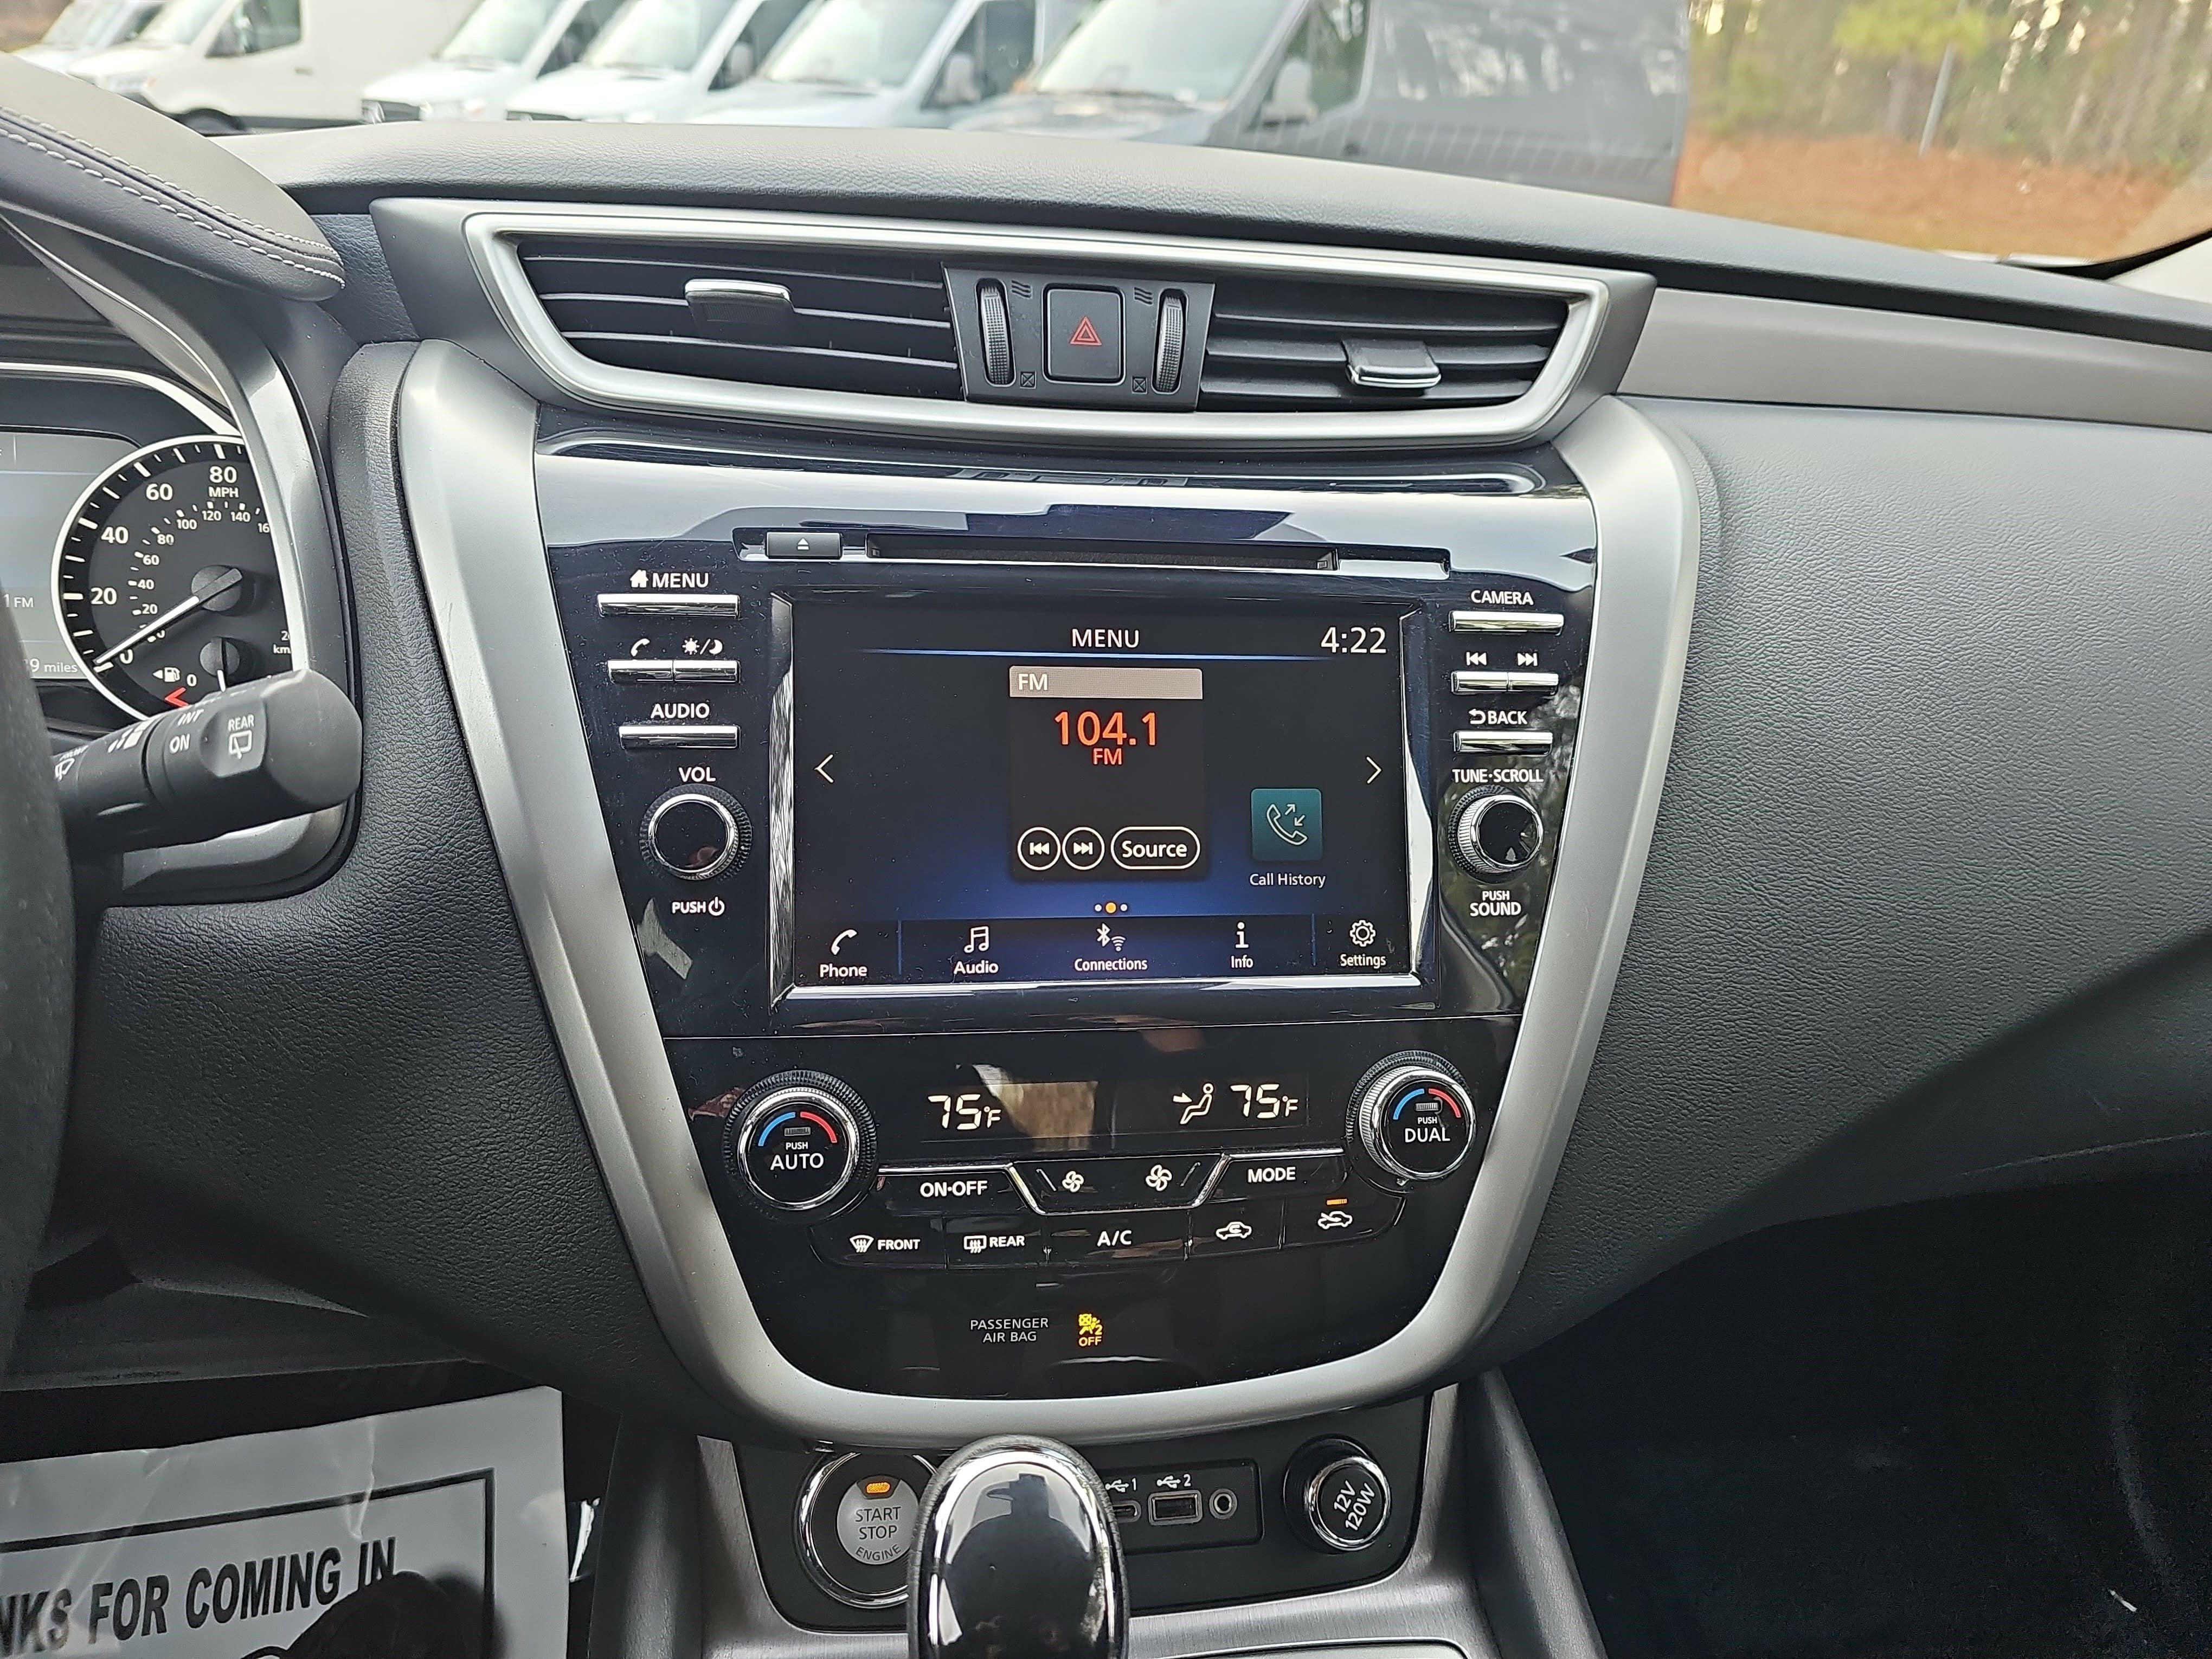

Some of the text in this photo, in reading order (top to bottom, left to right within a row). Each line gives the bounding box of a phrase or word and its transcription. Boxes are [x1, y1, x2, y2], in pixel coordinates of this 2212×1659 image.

[209, 466, 237, 483] 80
[146, 483, 173, 500] 60
[208, 486, 239, 498] MPH
[202, 510, 222, 521] 120
[230, 512, 251, 522] 140
[176, 519, 197, 530] 100
[258, 523, 269, 533] 16
[101, 526, 128, 544] 40
[157, 535, 175, 545] 80
[143, 555, 159, 565] 60
[138, 579, 155, 590] 40
[652, 573, 709, 588] MENU
[14, 597, 34, 608] FM
[91, 587, 117, 605] 20
[1471, 590, 1534, 606] CAMERA
[142, 603, 158, 614] 20
[1072, 628, 1139, 648] MENU
[1321, 627, 1386, 653] 4:22
[44, 663, 78, 673] miles
[1018, 673, 1049, 690] FM
[177, 709, 204, 726] INT
[651, 703, 710, 719] AUDIO
[1488, 710, 1528, 725] BACK
[228, 714, 255, 731] REAR
[1054, 711, 1155, 746] 104.1
[169, 734, 191, 754] ON
[1093, 748, 1122, 765] FM
[678, 767, 716, 782] VOL
[1122, 840, 1187, 858] Source
[1250, 872, 1326, 888] Call History
[1482, 890, 1510, 901] PUSH
[672, 901, 706, 914] PUSH
[1470, 903, 1521, 916] SOUND
[953, 960, 999, 974] Audio
[1075, 957, 1148, 971] Connections
[1231, 956, 1253, 968] Info
[1340, 954, 1386, 969] Settings
[820, 963, 867, 978] Phone
[1405, 1128, 1451, 1143] DUAL
[786, 1141, 808, 1150] PUSH
[770, 1153, 824, 1171] AUTO
[1248, 1166, 1296, 1183] MODE
[878, 1239, 921, 1250] FRONT
[989, 1235, 1025, 1248] REAR
[1097, 1230, 1132, 1247] A/C
[970, 1317, 1049, 1330] PASSENGER
[982, 1331, 1037, 1343] AIR BAG
[1078, 1336, 1102, 1347] OFF
[1184, 1474, 1191, 1487] 2
[1334, 1480, 1355, 1513] 12V
[1345, 1482, 1375, 1531] 120W
[855, 1507, 902, 1522] START
[859, 1525, 897, 1540] STOP
[856, 1544, 901, 1561] ENGINE
[88, 1574, 169, 1644] FOR
[186, 1547, 341, 1629] COMING
[358, 1536, 396, 1591] IN
